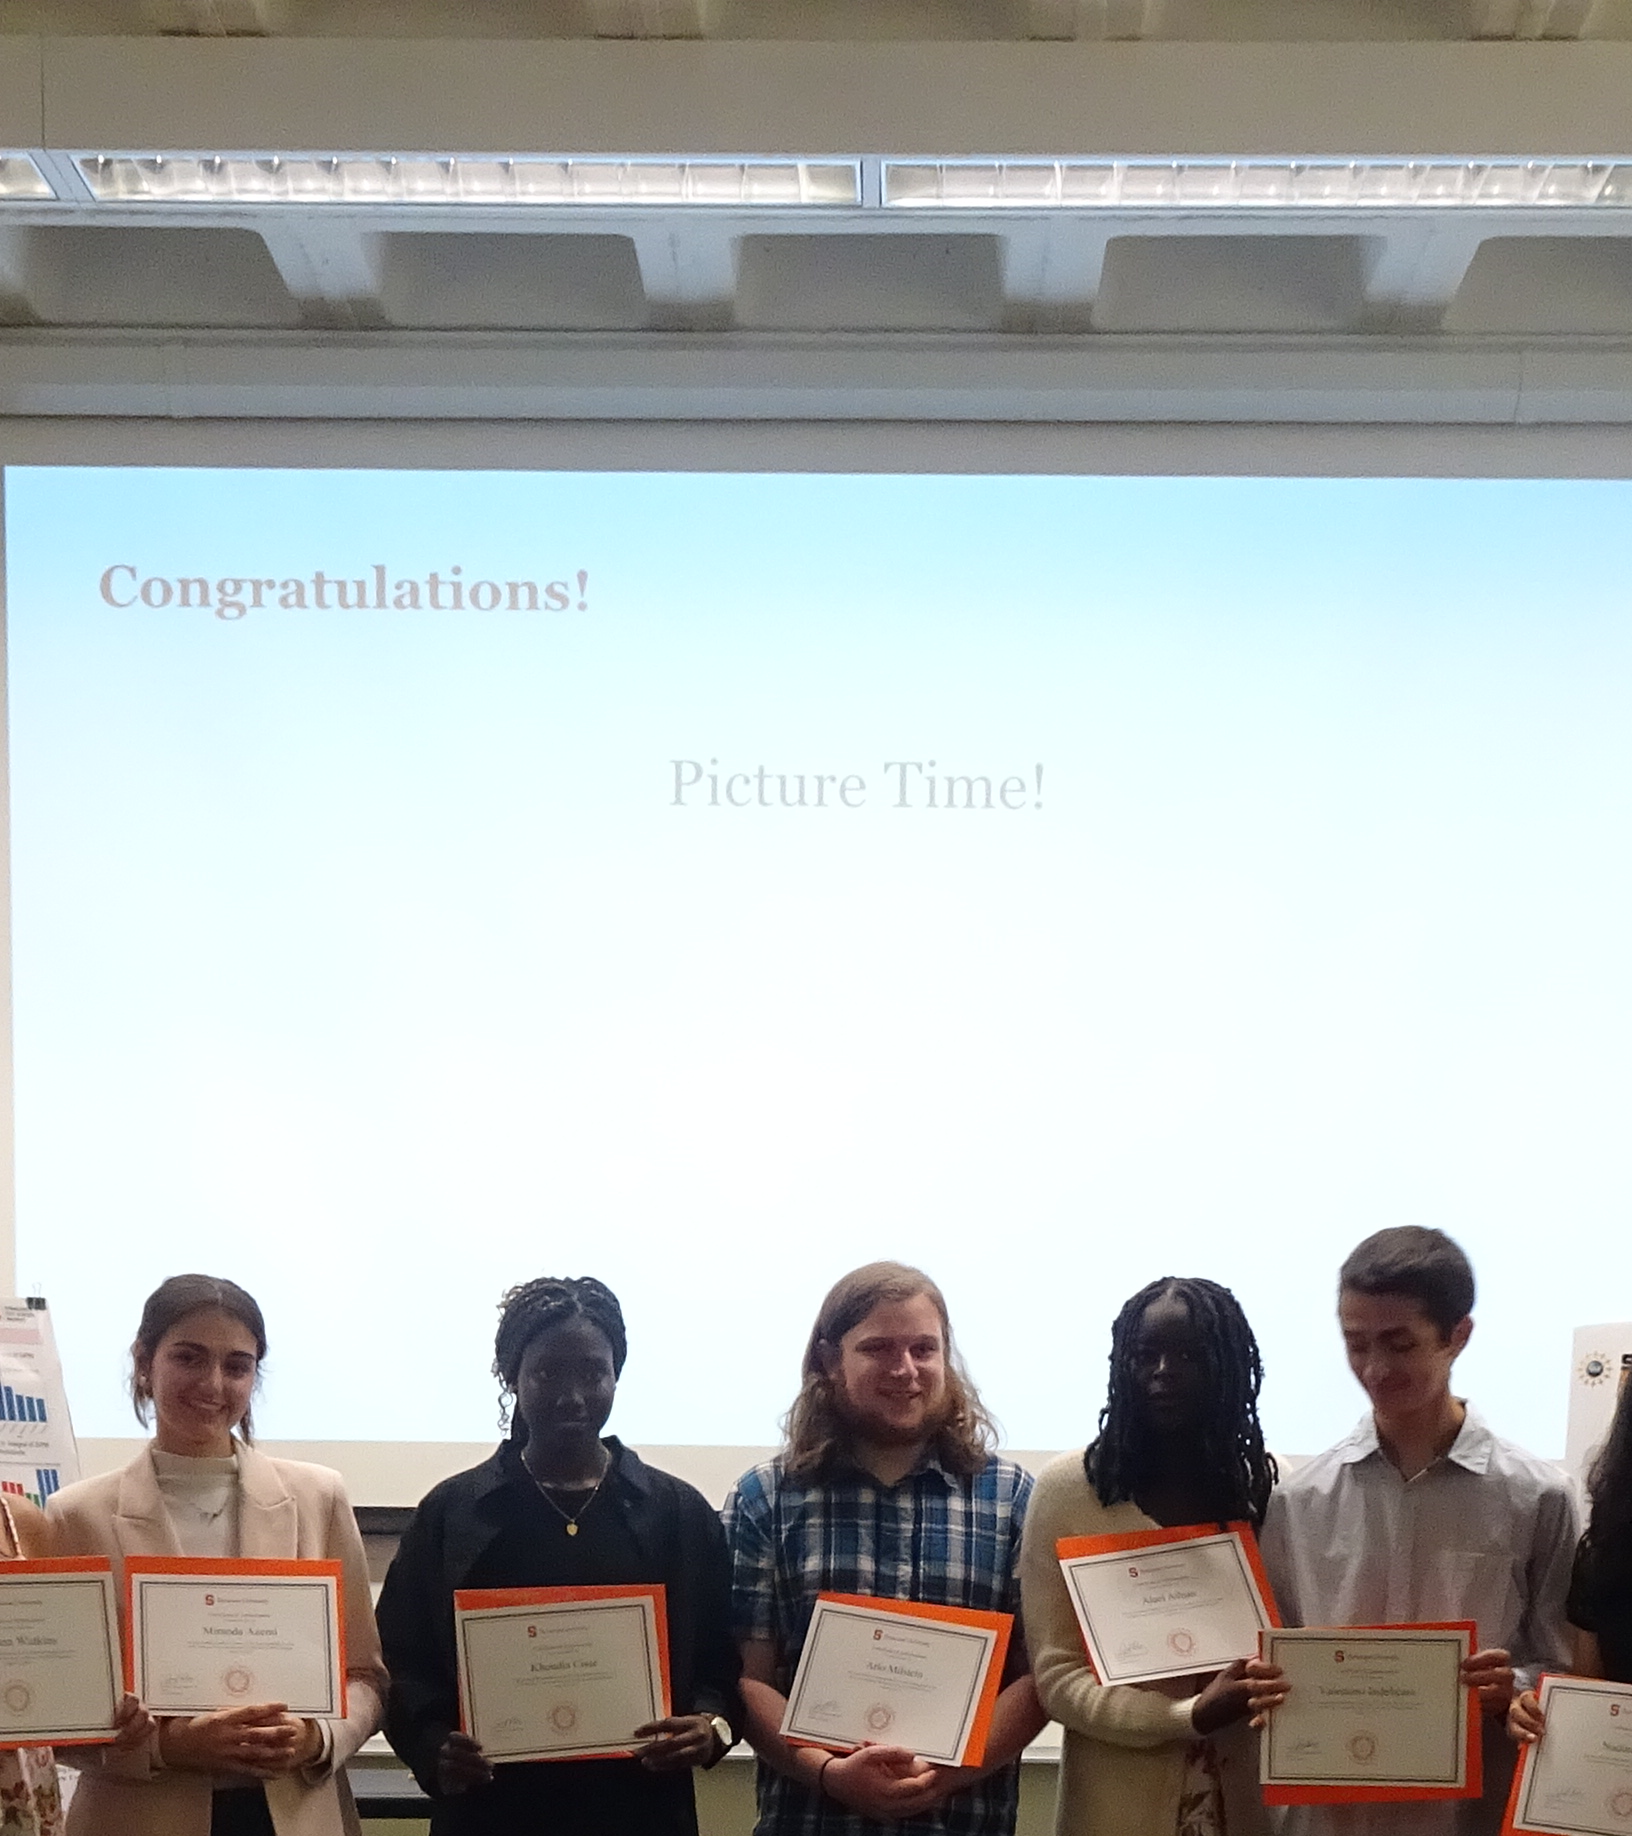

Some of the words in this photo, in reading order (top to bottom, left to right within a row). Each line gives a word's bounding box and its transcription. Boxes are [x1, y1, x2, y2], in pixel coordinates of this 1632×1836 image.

[99, 563, 591, 621] Congratulations!
[669, 756, 867, 809] Picture
[884, 760, 1046, 810] Time!
[1128, 1566, 1139, 1578] S
[205, 1594, 215, 1606] S
[527, 1626, 537, 1638] S
[873, 1629, 883, 1641] S
[1334, 1650, 1345, 1663] S
[1610, 1703, 1620, 1716] S
